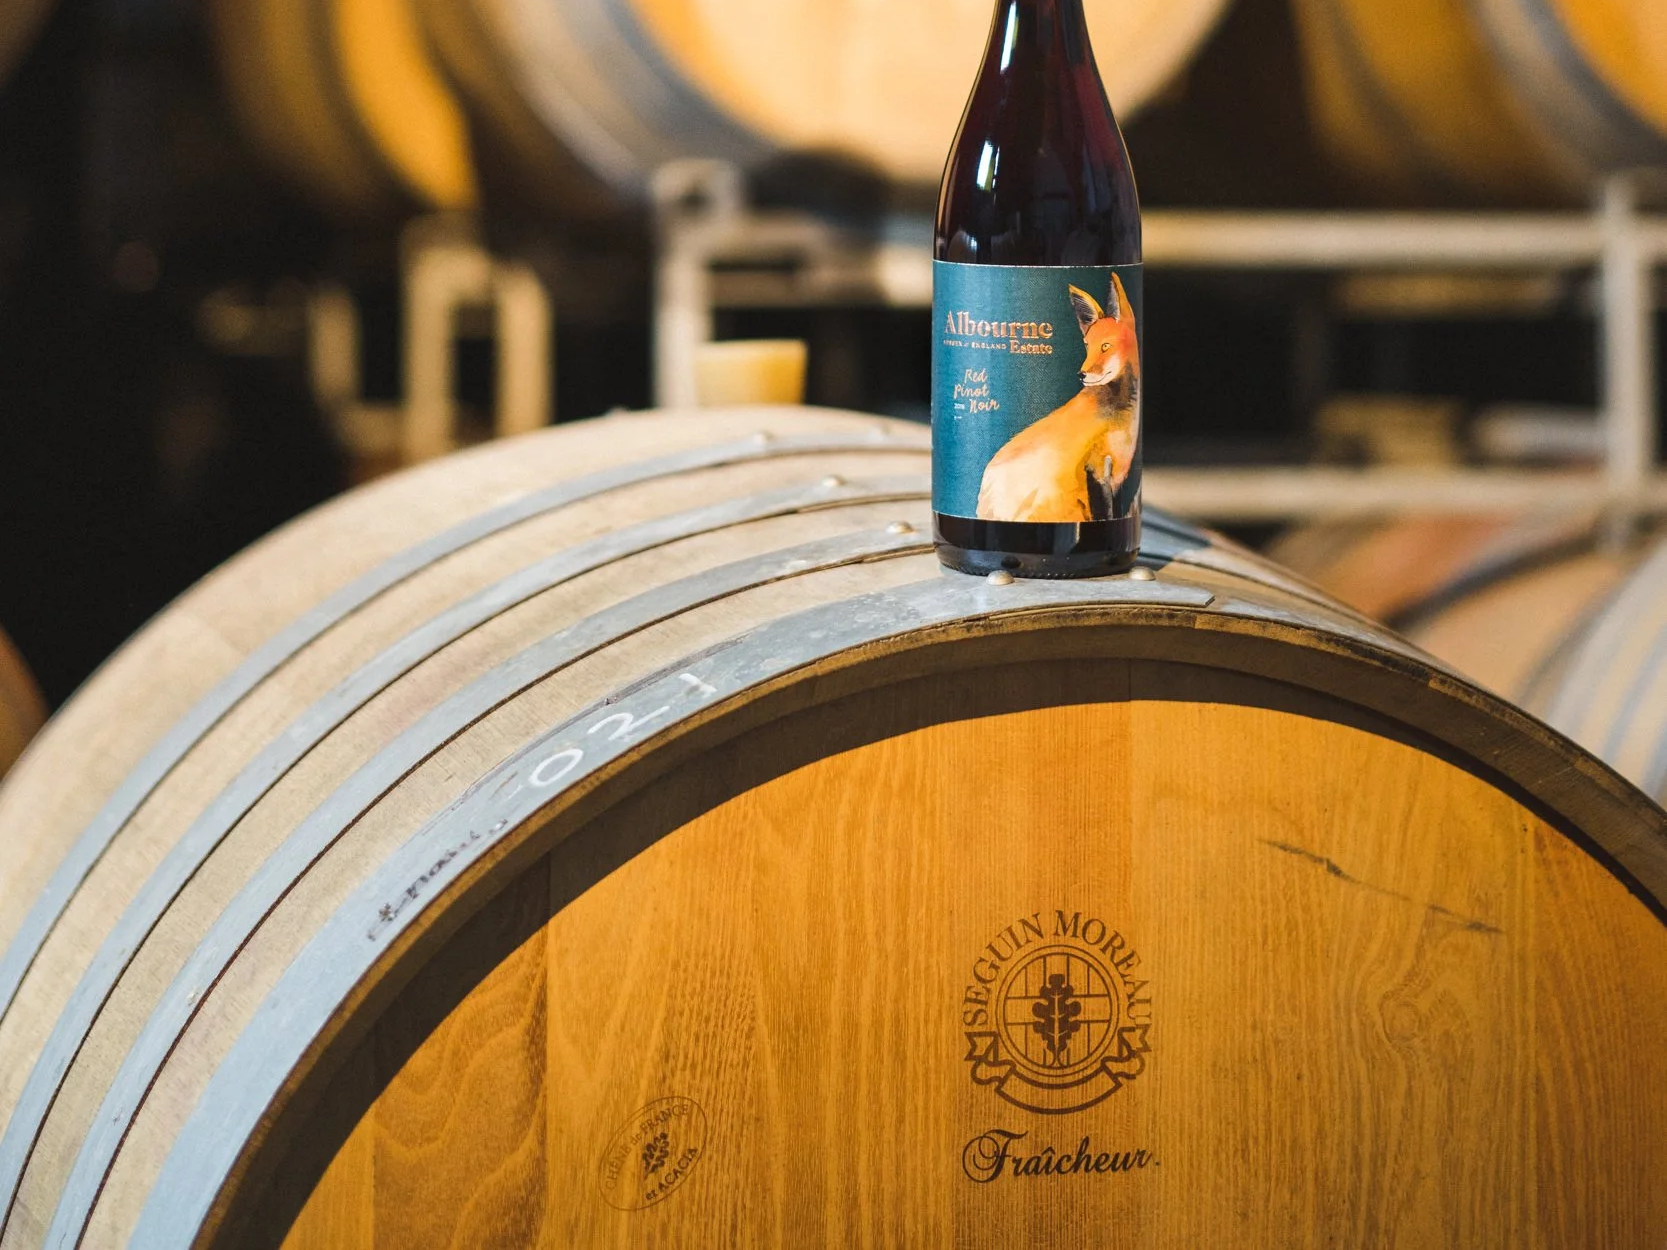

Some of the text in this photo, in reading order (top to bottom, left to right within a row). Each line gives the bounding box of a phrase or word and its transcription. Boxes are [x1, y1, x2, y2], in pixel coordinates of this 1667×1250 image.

[944, 310, 1053, 339] Albourne
[971, 341, 1007, 350] ENGLAND
[1009, 339, 1053, 355] Estate
[964, 367, 988, 384] Red
[953, 384, 990, 400] Pinot
[968, 397, 1000, 414] Noir
[962, 909, 1153, 1028] SEGUIN MOREAU
[640, 1104, 690, 1136] FRANCE
[658, 1147, 698, 1191] ACACIA
